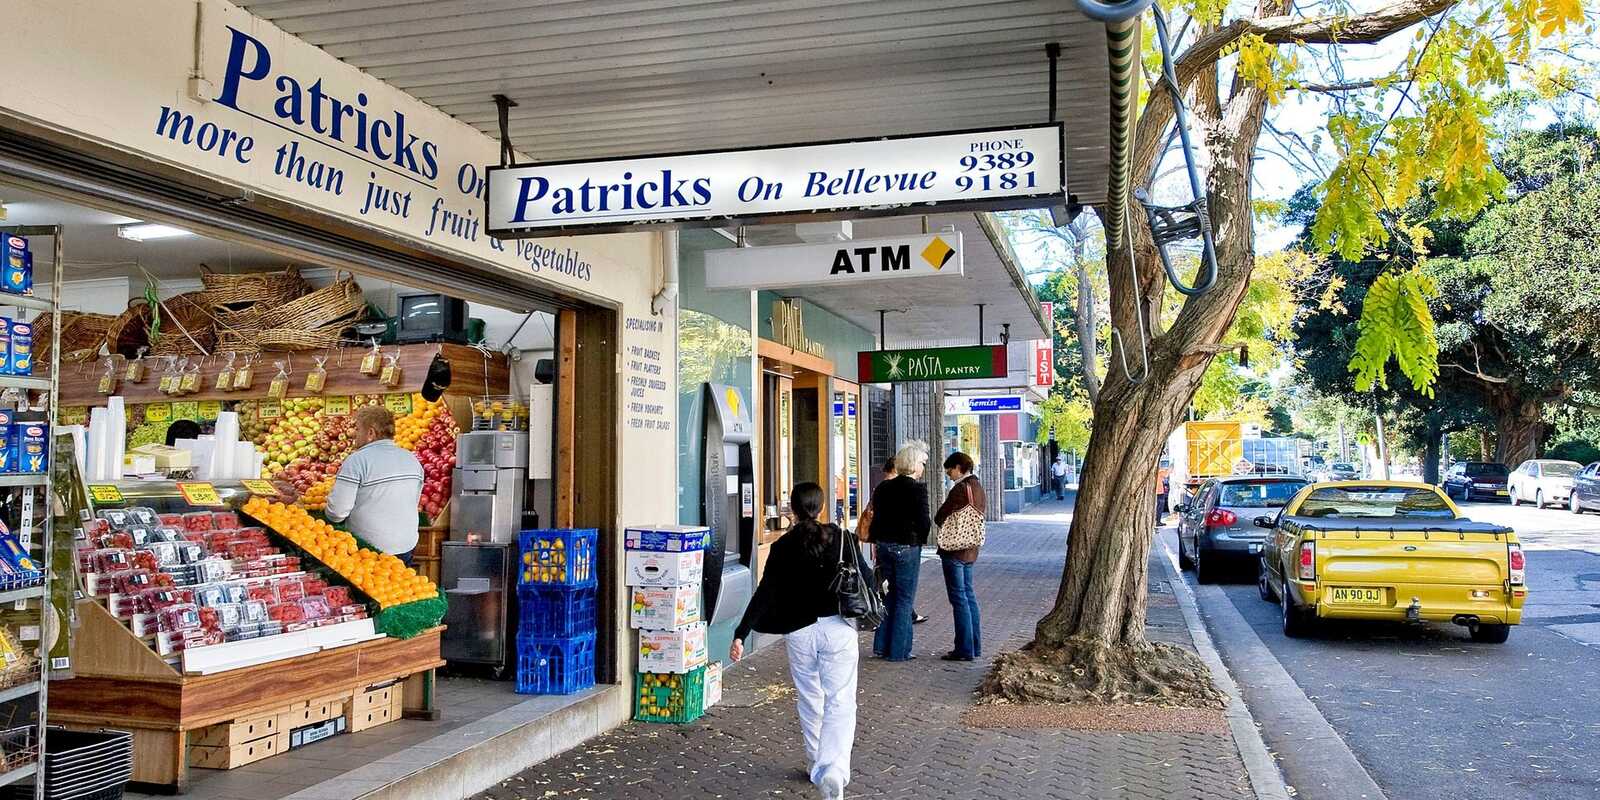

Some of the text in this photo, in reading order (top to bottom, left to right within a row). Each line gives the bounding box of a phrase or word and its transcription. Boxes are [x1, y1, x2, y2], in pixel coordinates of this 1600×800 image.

[212, 25, 438, 181] Patricks
[969, 138, 1024, 154] PHONE
[960, 150, 1035, 172] 9389
[954, 170, 1039, 193] 9181
[155, 105, 254, 164] more
[275, 141, 344, 196] than
[360, 171, 412, 219] just
[425, 198, 479, 242] fruit
[516, 239, 593, 281] vegetables
[508, 168, 937, 224] Patricks On Bellevue
[830, 244, 911, 275] ATM
[625, 318, 657, 332] SPECIALISING
[631, 345, 661, 361] FRUIT BASKETS
[631, 360, 662, 375] FRUIT PLATTERS
[908, 354, 981, 378] PASTA PANTRY
[631, 402, 643, 413] FRESH
[631, 418, 643, 429] FRESH
[1334, 589, 1348, 600] AN
[1350, 589, 1363, 600] 90
